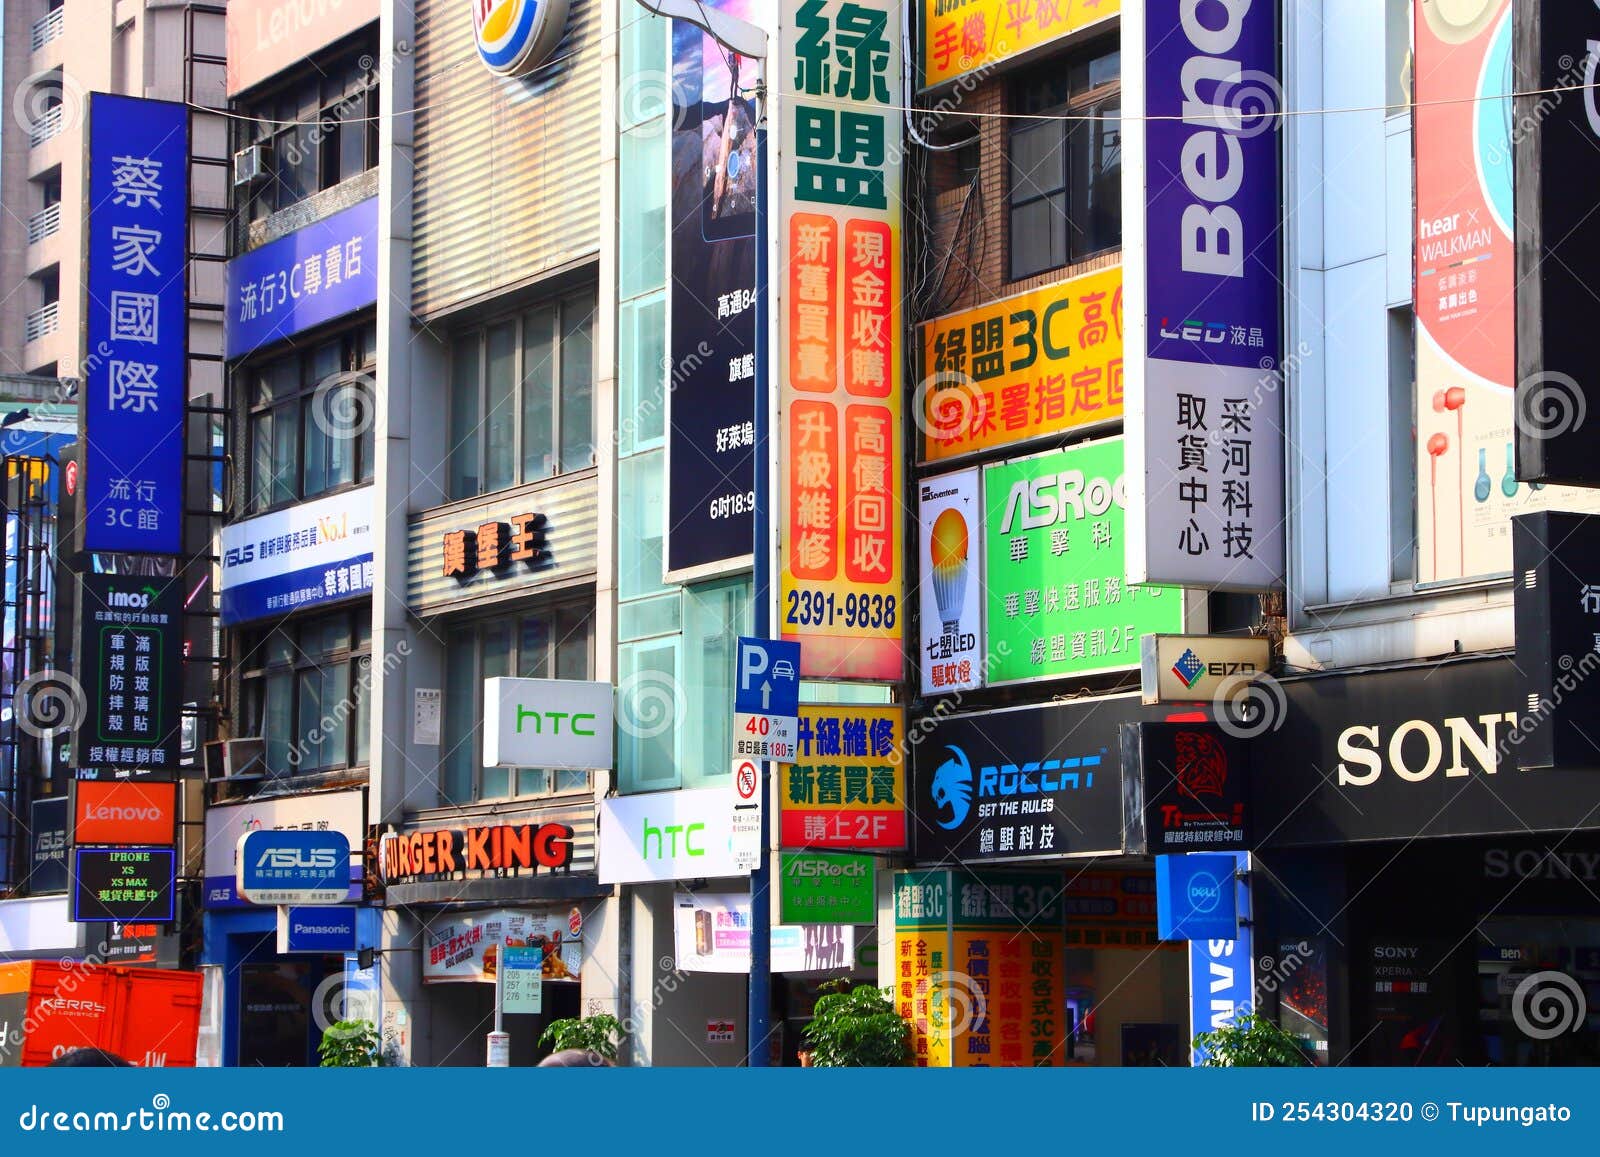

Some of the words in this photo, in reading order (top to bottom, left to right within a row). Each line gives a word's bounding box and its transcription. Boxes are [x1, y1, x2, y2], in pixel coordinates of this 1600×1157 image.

[794, 0, 890, 210] 綠盟
[1420, 228, 1492, 262] WALKMAN
[108, 155, 162, 412] 蔡家國際
[239, 236, 364, 323] 流行3C專賣店
[796, 223, 832, 382] 新舊買賣
[852, 230, 886, 388] 現金收購
[935, 298, 1070, 391] 綠盟3C
[1230, 325, 1264, 347] 液晶
[108, 478, 157, 502] 流行
[1176, 393, 1210, 556] 取貨中心
[1221, 398, 1254, 560] 采河科技
[797, 411, 831, 571] 升級維修
[853, 416, 887, 573] 高價回收
[105, 507, 159, 530] 3C館
[222, 543, 255, 569] ASUS
[318, 511, 348, 545] No.1
[443, 512, 538, 577] 漢堡王
[324, 561, 374, 597] 蔡家國際
[786, 589, 897, 629] 2391-9838
[926, 633, 976, 661] 七盟LED
[1030, 625, 1136, 664] 綠盟資訊2F
[133, 634, 151, 731] 滿版玻璃貼
[741, 645, 769, 690] P
[931, 660, 972, 687] 驅蚊燈
[1208, 662, 1256, 677] EIZO
[745, 716, 769, 736] 40
[89, 746, 166, 764] 授權經銷商
[789, 764, 897, 805] 新舊買賣
[978, 754, 1102, 797] ROCCAT
[86, 803, 161, 821] Lenovo
[978, 803, 996, 818] SET
[999, 801, 1018, 816] THE
[1021, 798, 1055, 814] RULES
[803, 814, 888, 842] 請上2F
[109, 852, 151, 862] IPHONE
[256, 848, 336, 868] ASUS
[467, 823, 568, 869] KING
[121, 865, 135, 875] XS
[788, 860, 867, 877] ASRock
[1484, 848, 1600, 880] SONY
[98, 889, 159, 902] 現貨供應中
[111, 878, 124, 888] XS
[126, 878, 148, 887] MAX
[1191, 886, 1218, 898] DELL
[899, 884, 944, 918] 綠盟3C
[961, 884, 1058, 918] 綠盟3C
[294, 923, 350, 934] Panasonic
[1374, 947, 1419, 958] SONY
[1375, 966, 1413, 976] XPERIA
[40, 997, 106, 1013] KERRY
[505, 992, 520, 1001] 276
